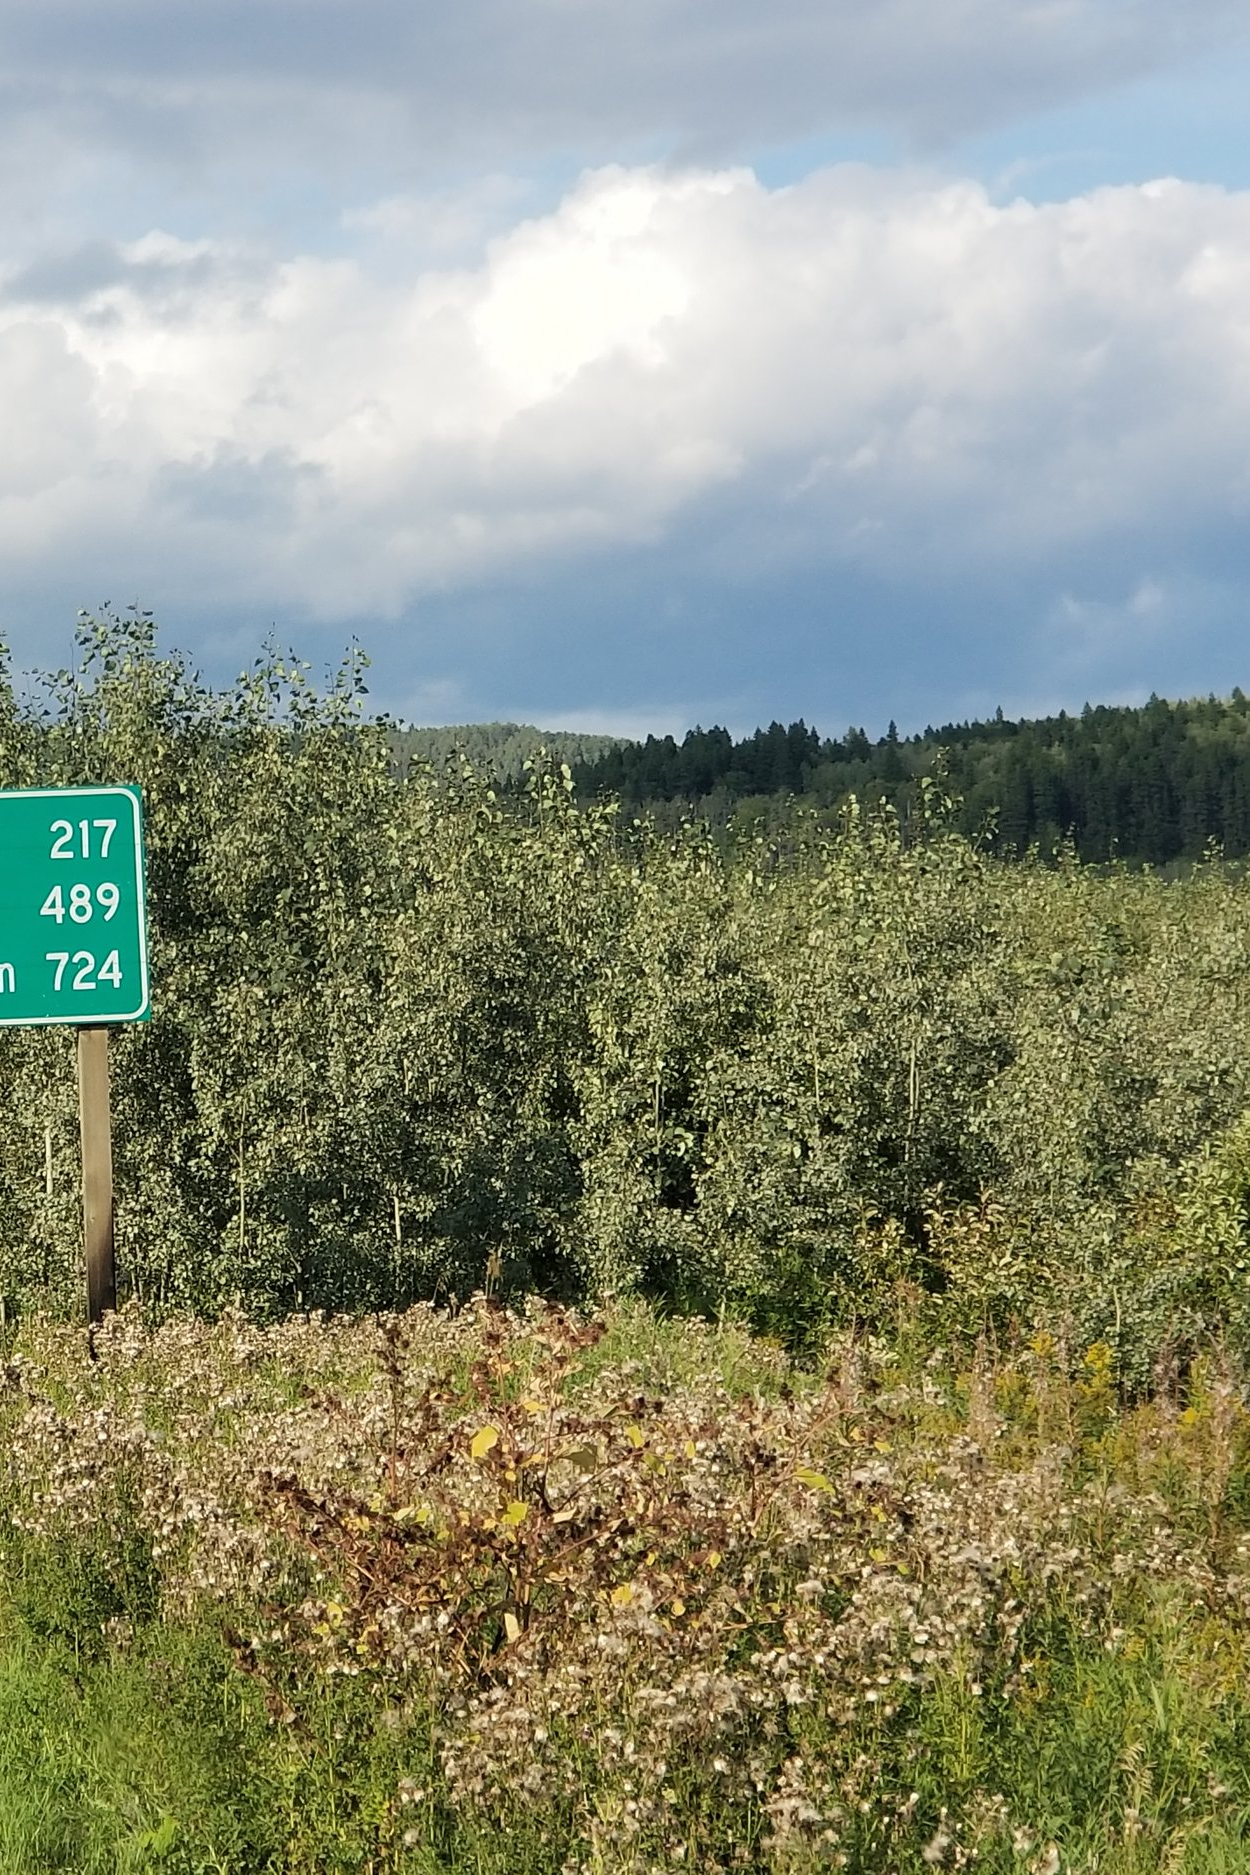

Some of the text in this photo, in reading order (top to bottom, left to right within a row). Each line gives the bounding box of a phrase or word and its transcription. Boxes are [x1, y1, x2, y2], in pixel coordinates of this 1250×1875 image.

[50, 819, 117, 859] 217
[39, 882, 120, 924] 489
[45, 949, 123, 991] 724
